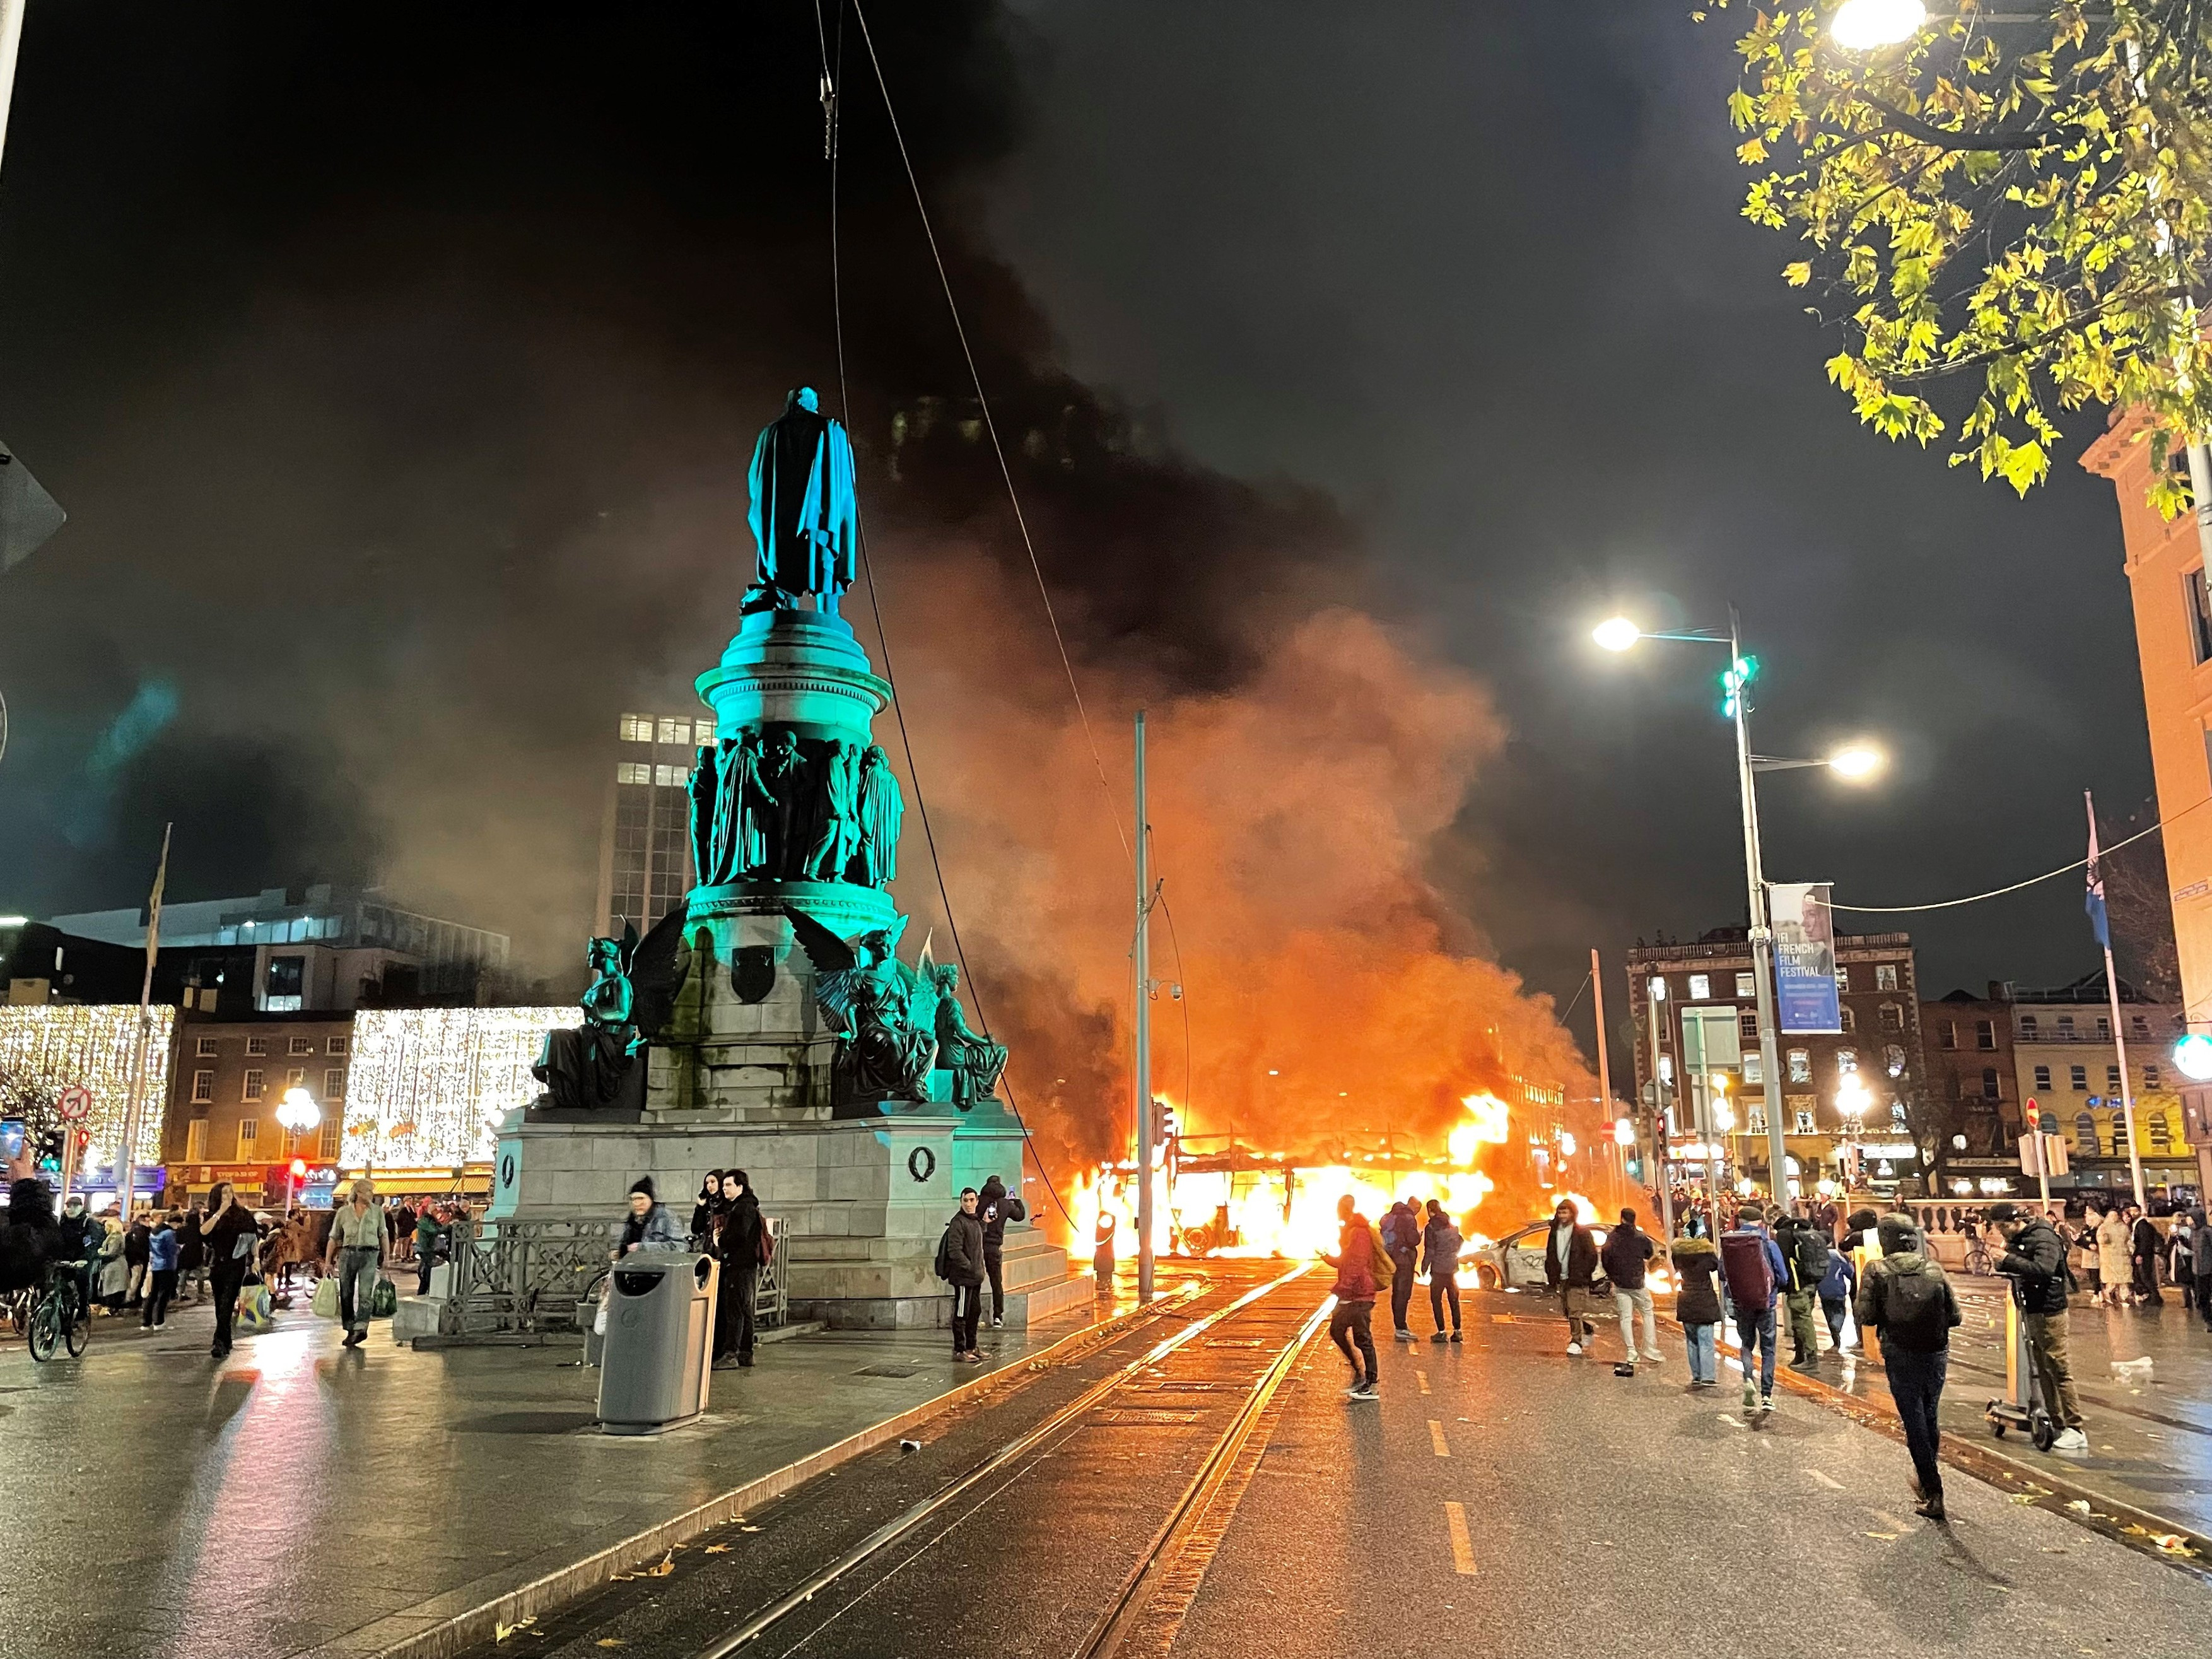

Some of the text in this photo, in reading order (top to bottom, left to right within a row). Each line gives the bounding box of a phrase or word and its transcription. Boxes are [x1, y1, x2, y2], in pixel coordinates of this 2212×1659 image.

[1777, 932, 1789, 943] IFI
[1779, 943, 1814, 954] FRENCH
[1779, 955, 1801, 966] FILM
[1780, 966, 1821, 977] FESTIVAL
